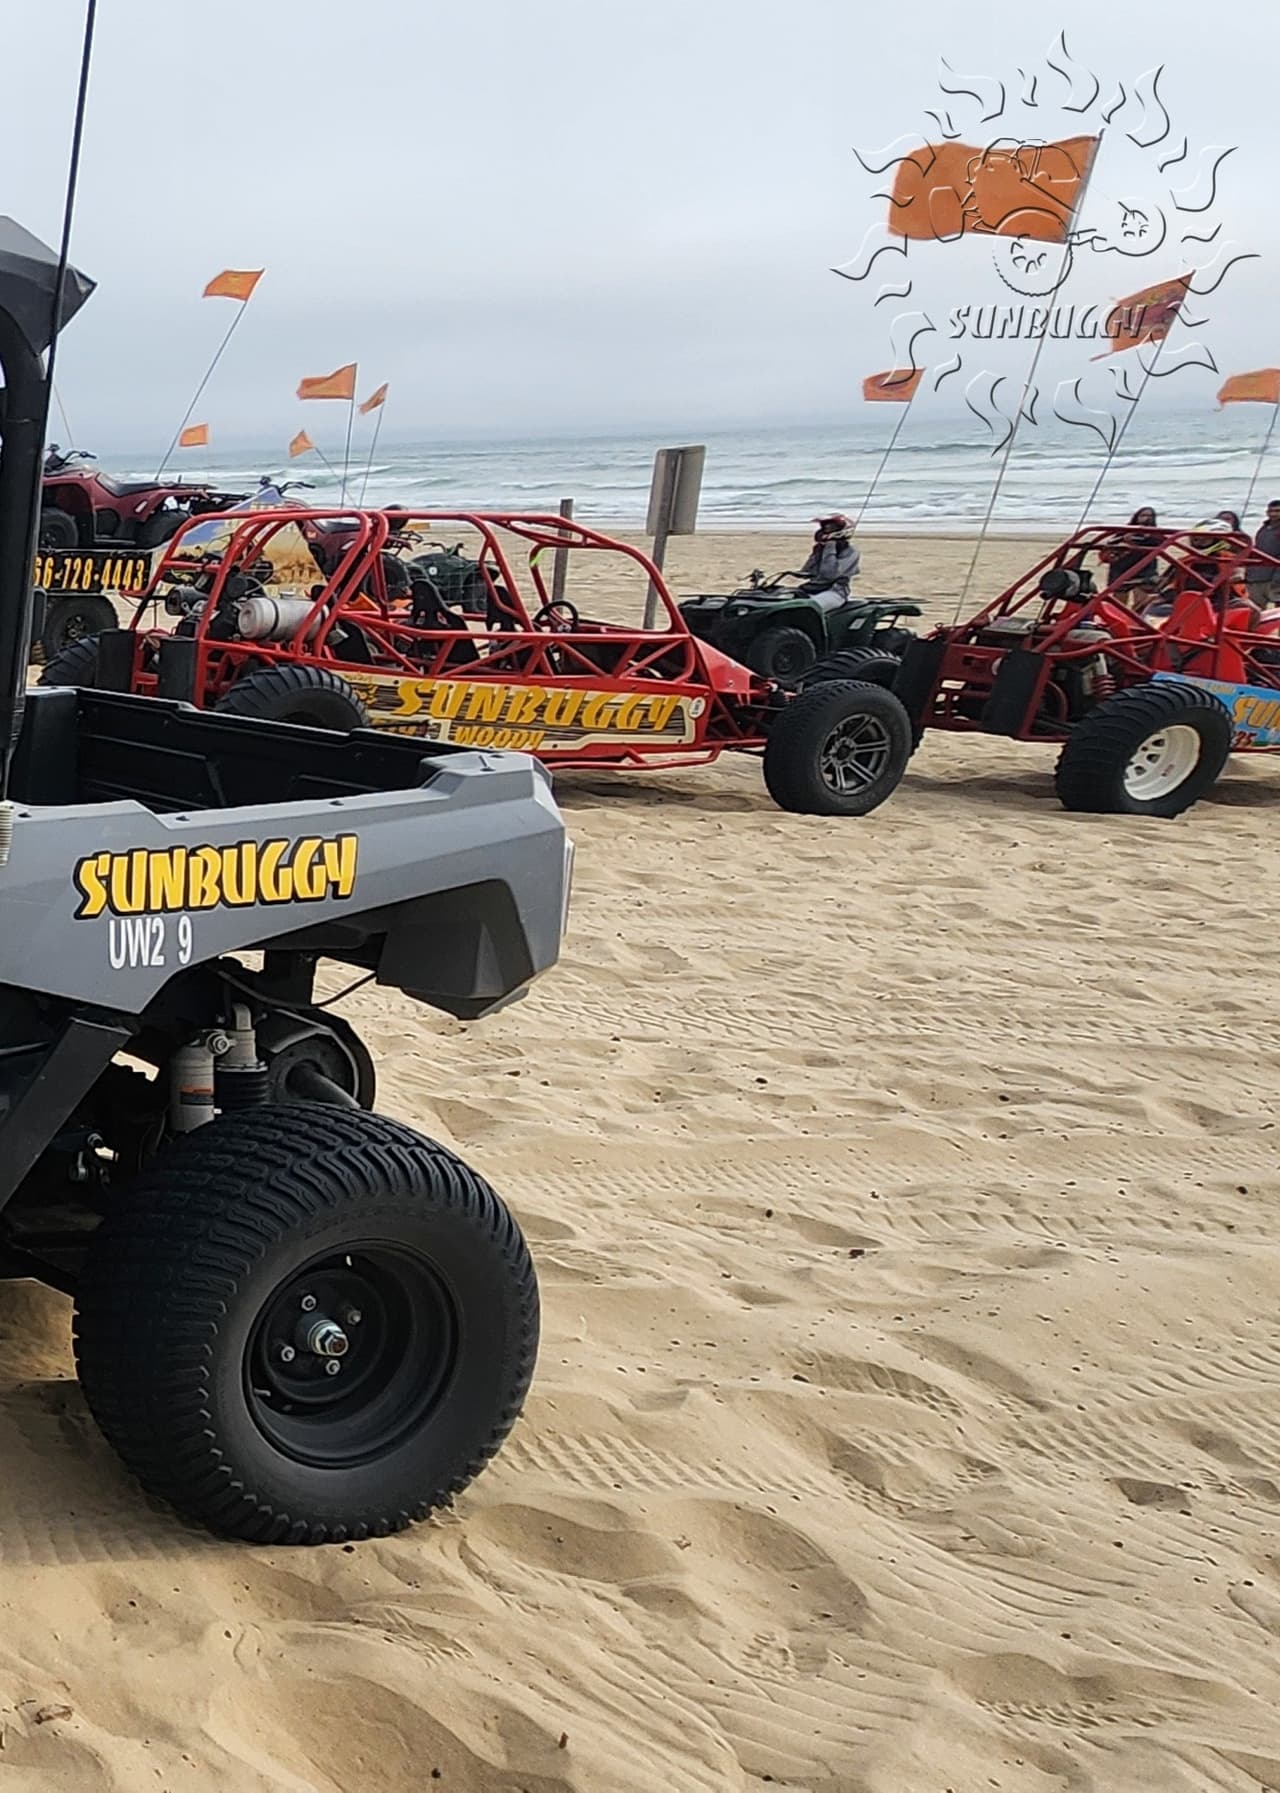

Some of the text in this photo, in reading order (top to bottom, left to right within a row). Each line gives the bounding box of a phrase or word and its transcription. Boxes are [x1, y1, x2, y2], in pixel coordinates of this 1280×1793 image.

[391, 678, 682, 732] SUNBUGGY
[454, 725, 545, 750] WOODY
[73, 833, 358, 920] SUNBUGGY
[109, 917, 192, 969] UW2 9
